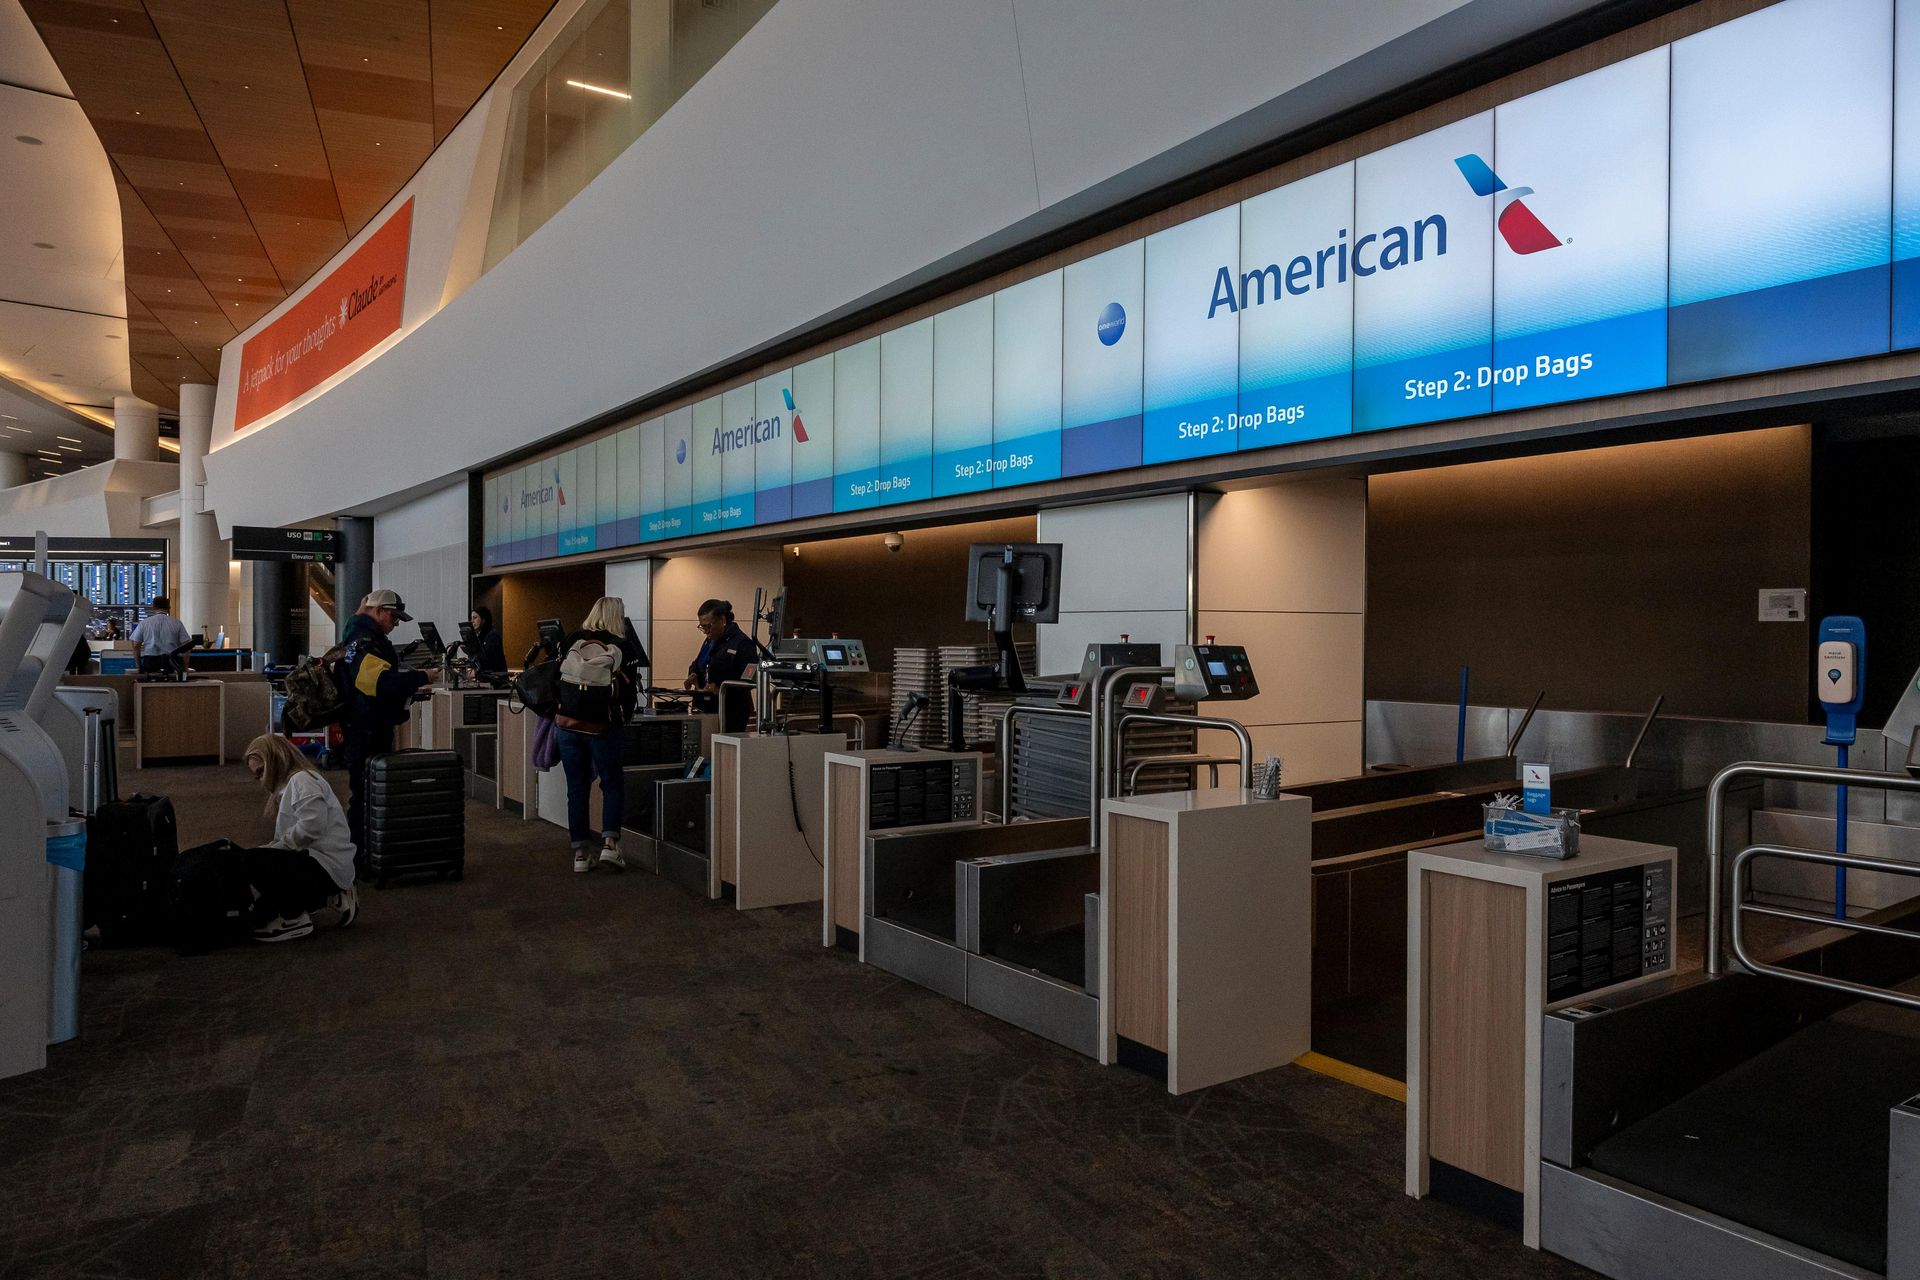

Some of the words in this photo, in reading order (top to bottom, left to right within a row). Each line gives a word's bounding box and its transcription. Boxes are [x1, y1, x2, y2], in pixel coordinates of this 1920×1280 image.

[1207, 214, 1447, 320] American
[348, 274, 378, 320] Claude
[275, 350, 286, 375] for
[285, 342, 303, 375] your
[303, 314, 337, 355] thoughts
[1405, 379, 1449, 400] Step
[1453, 371, 1472, 391] 2:
[1477, 364, 1529, 389] Drop
[1535, 353, 1594, 378] Bags
[712, 416, 781, 456] American
[1179, 422, 1209, 440] Step
[1211, 416, 1225, 433] 2:
[1227, 413, 1262, 430] Drop
[1266, 405, 1305, 425] Bags
[955, 464, 975, 479] Step
[975, 461, 985, 475] 2:
[985, 458, 1008, 474] Drop
[1009, 454, 1034, 471] Bags
[521, 486, 554, 509] American
[850, 484, 867, 497] Step
[874, 478, 892, 493] Drop
[892, 475, 911, 490] Bags
[287, 531, 302, 539] USO
